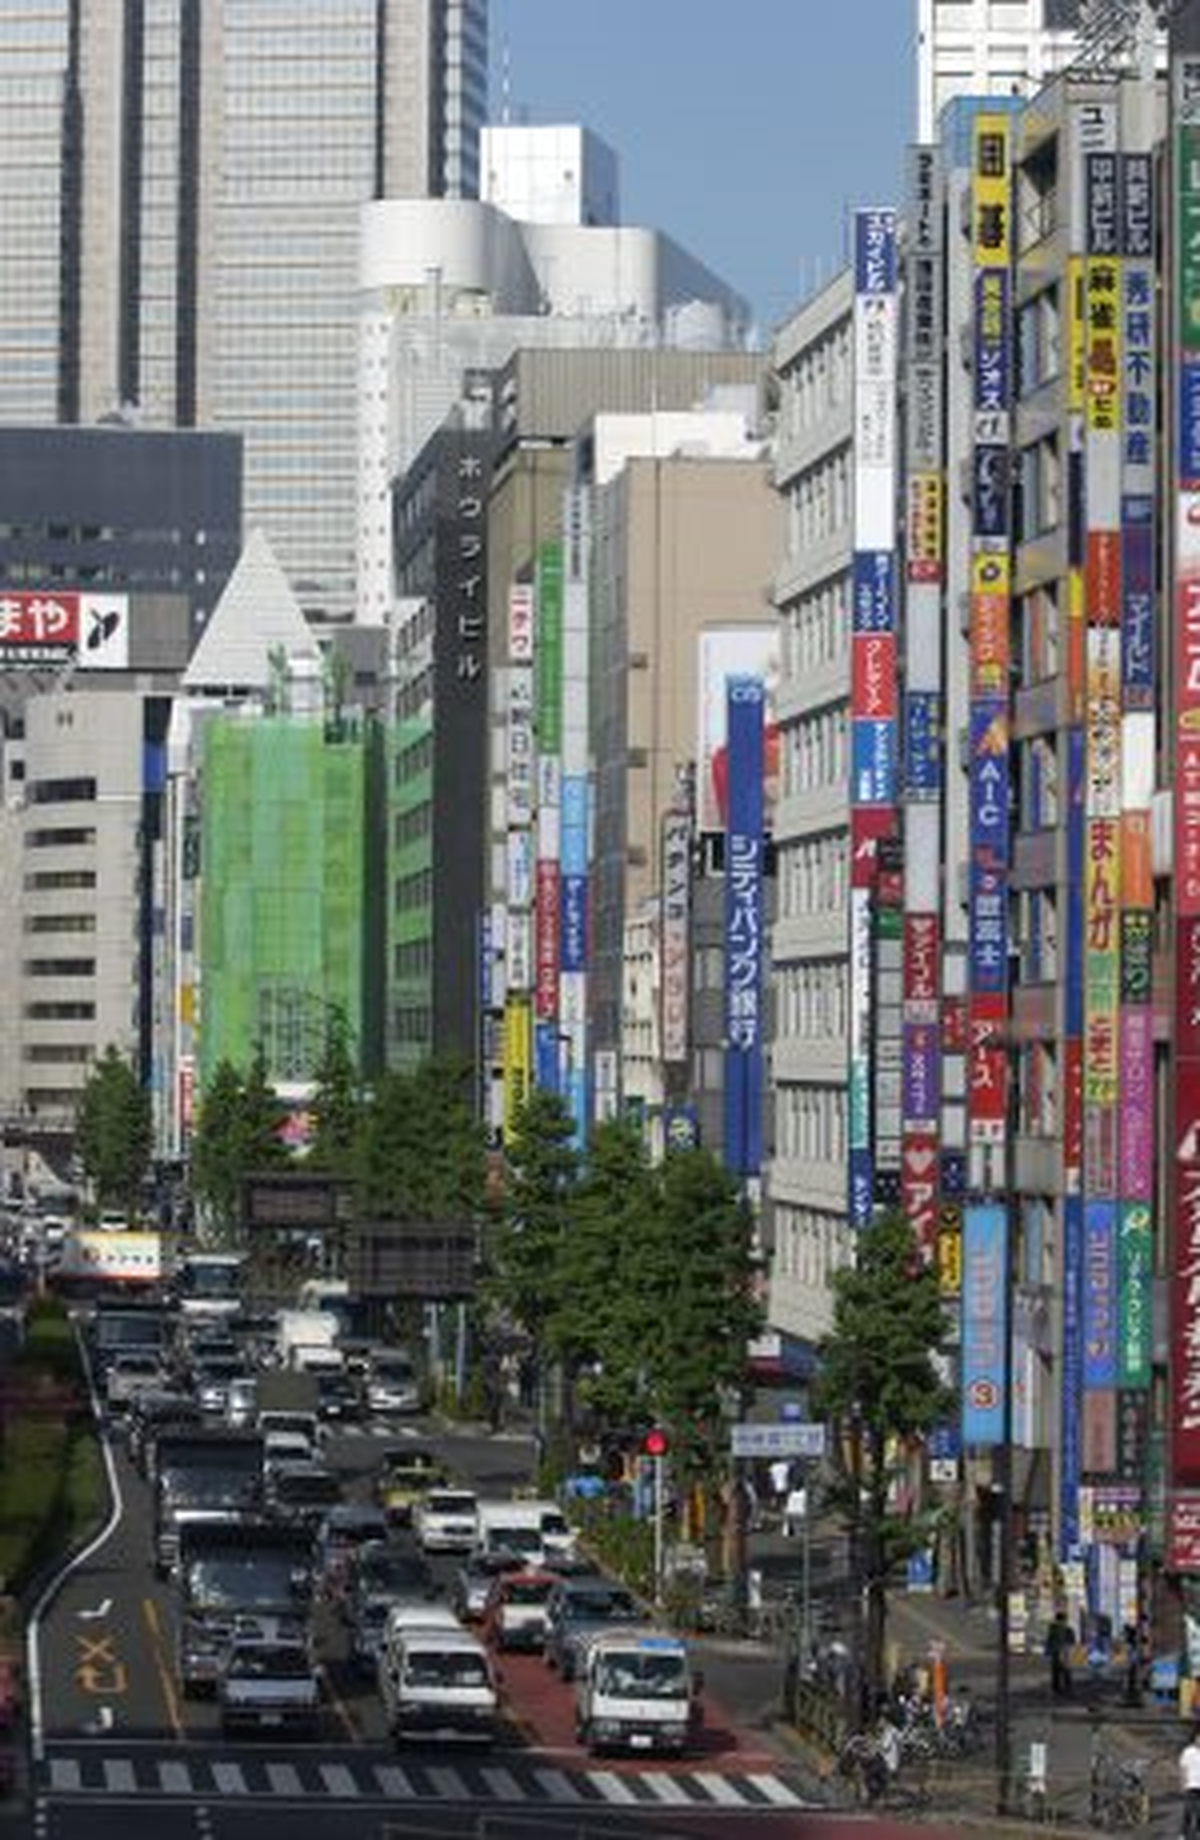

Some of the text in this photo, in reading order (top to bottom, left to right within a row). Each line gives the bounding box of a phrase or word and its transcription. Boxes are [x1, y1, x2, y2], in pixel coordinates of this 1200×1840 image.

[458, 456, 482, 677] ホウライビル
[731, 836, 758, 1051] シティバンク銀行
